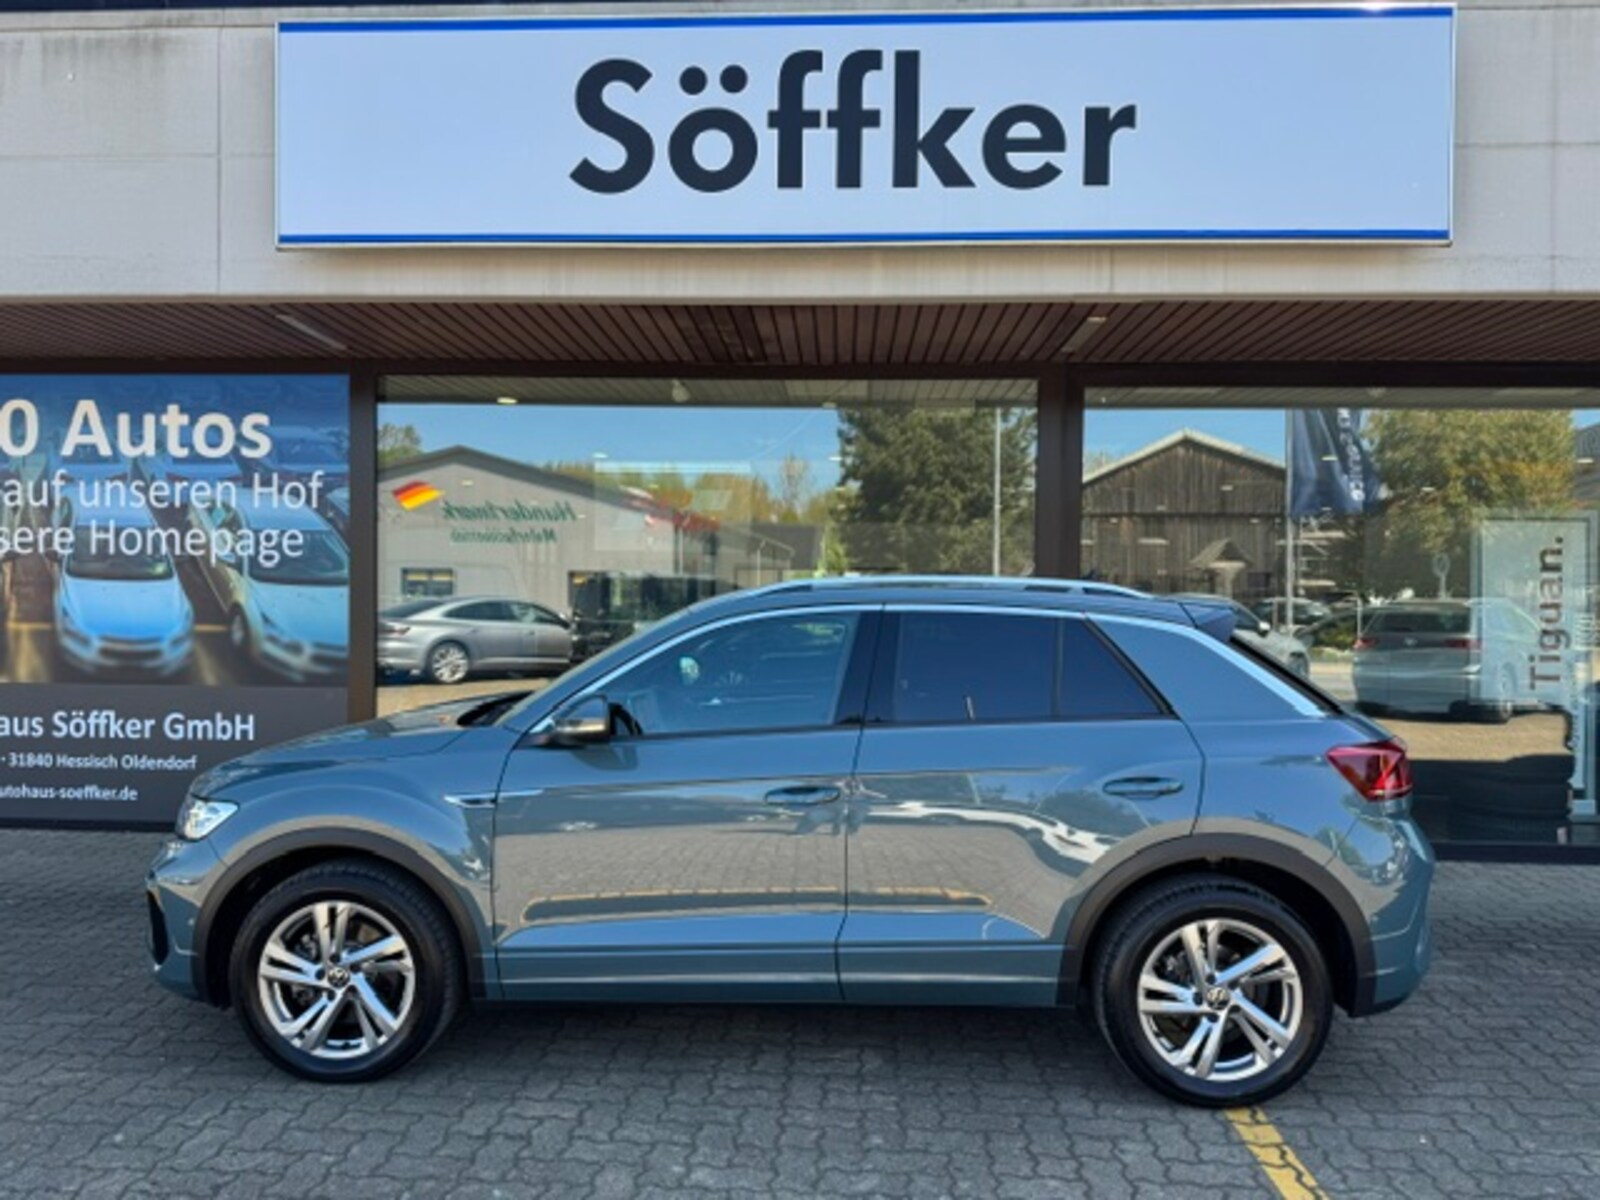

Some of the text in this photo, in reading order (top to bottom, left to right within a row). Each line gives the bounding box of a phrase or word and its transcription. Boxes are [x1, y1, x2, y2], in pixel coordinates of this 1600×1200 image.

[568, 49, 1137, 193] Söffker
[60, 399, 273, 459] Autos
[3, 469, 325, 509] auf unseren Hof
[91, 519, 304, 568] Homepage
[1529, 536, 1571, 691] Tiguan.
[0, 709, 256, 741] aus Söffker GmbH
[8, 752, 197, 771] 31840 Hessisch Oldendorf
